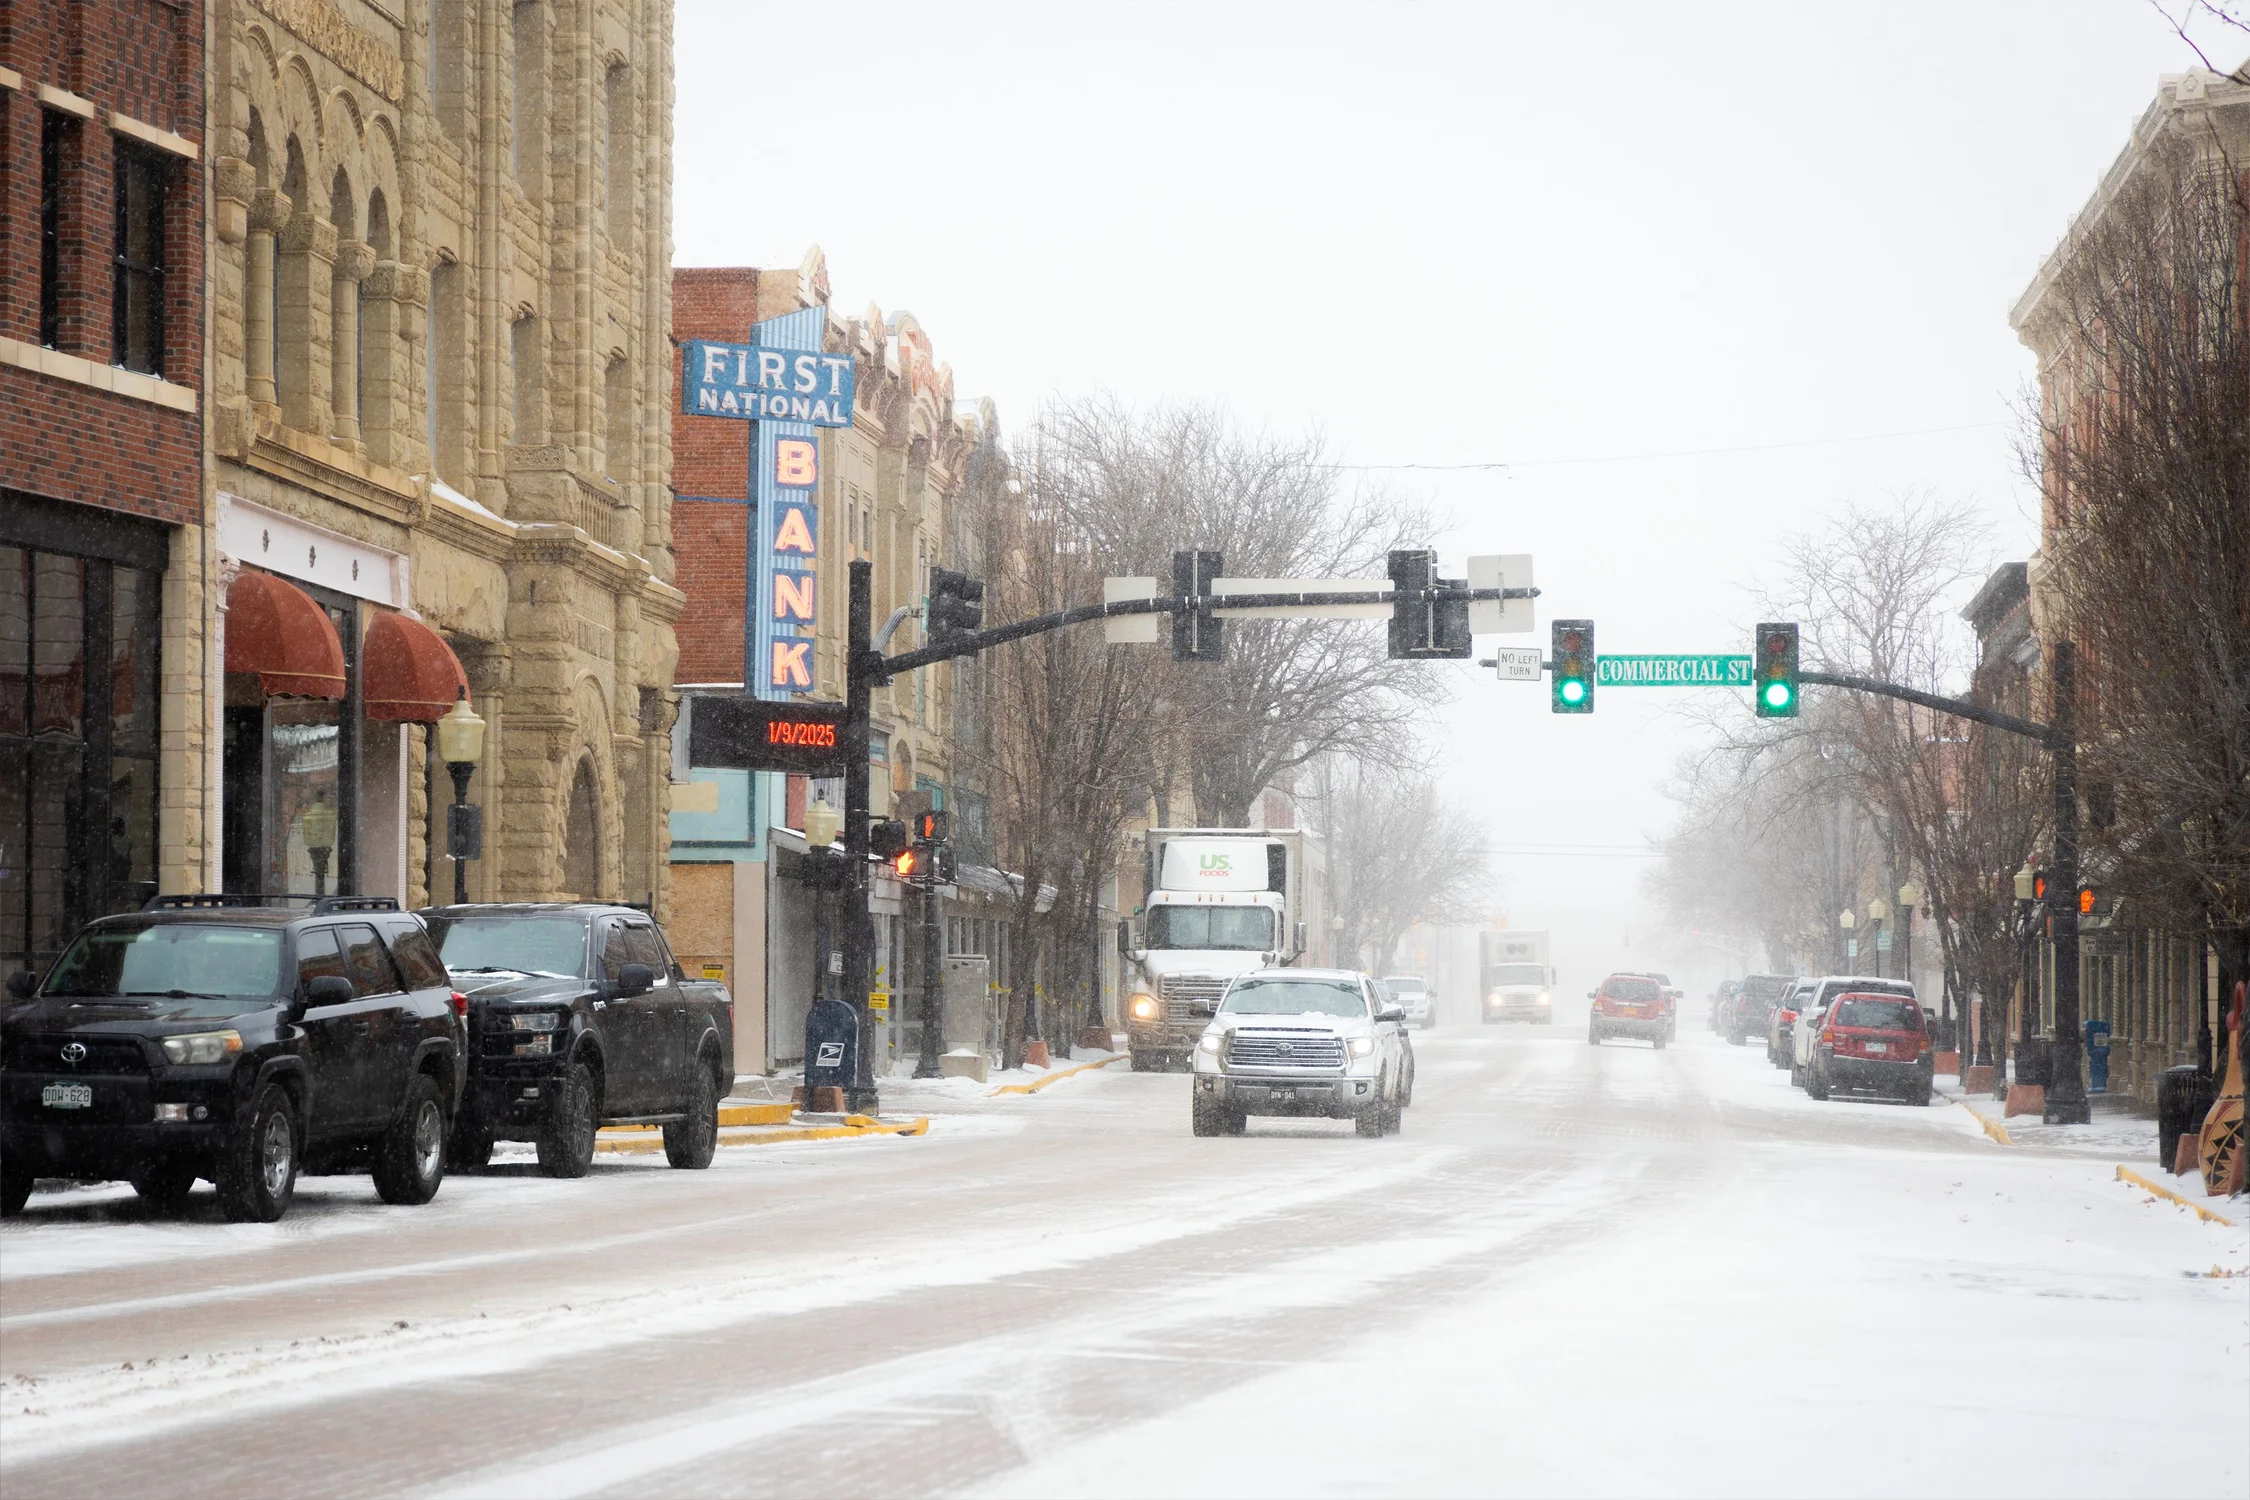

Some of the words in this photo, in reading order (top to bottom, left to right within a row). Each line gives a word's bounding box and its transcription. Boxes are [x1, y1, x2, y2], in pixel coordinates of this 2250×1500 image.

[702, 344, 850, 396] FIRST
[698, 387, 848, 424] NATIONAL
[773, 440, 816, 687] BANK
[1501, 653, 1515, 664] NO
[1518, 655, 1539, 665] LEFT
[1509, 666, 1531, 676] TURN
[1598, 660, 1723, 682] COMMERCIAL
[1728, 660, 1751, 682] ST
[768, 721, 836, 747] 1/9/2025
[1199, 869, 1230, 877] FOODS
